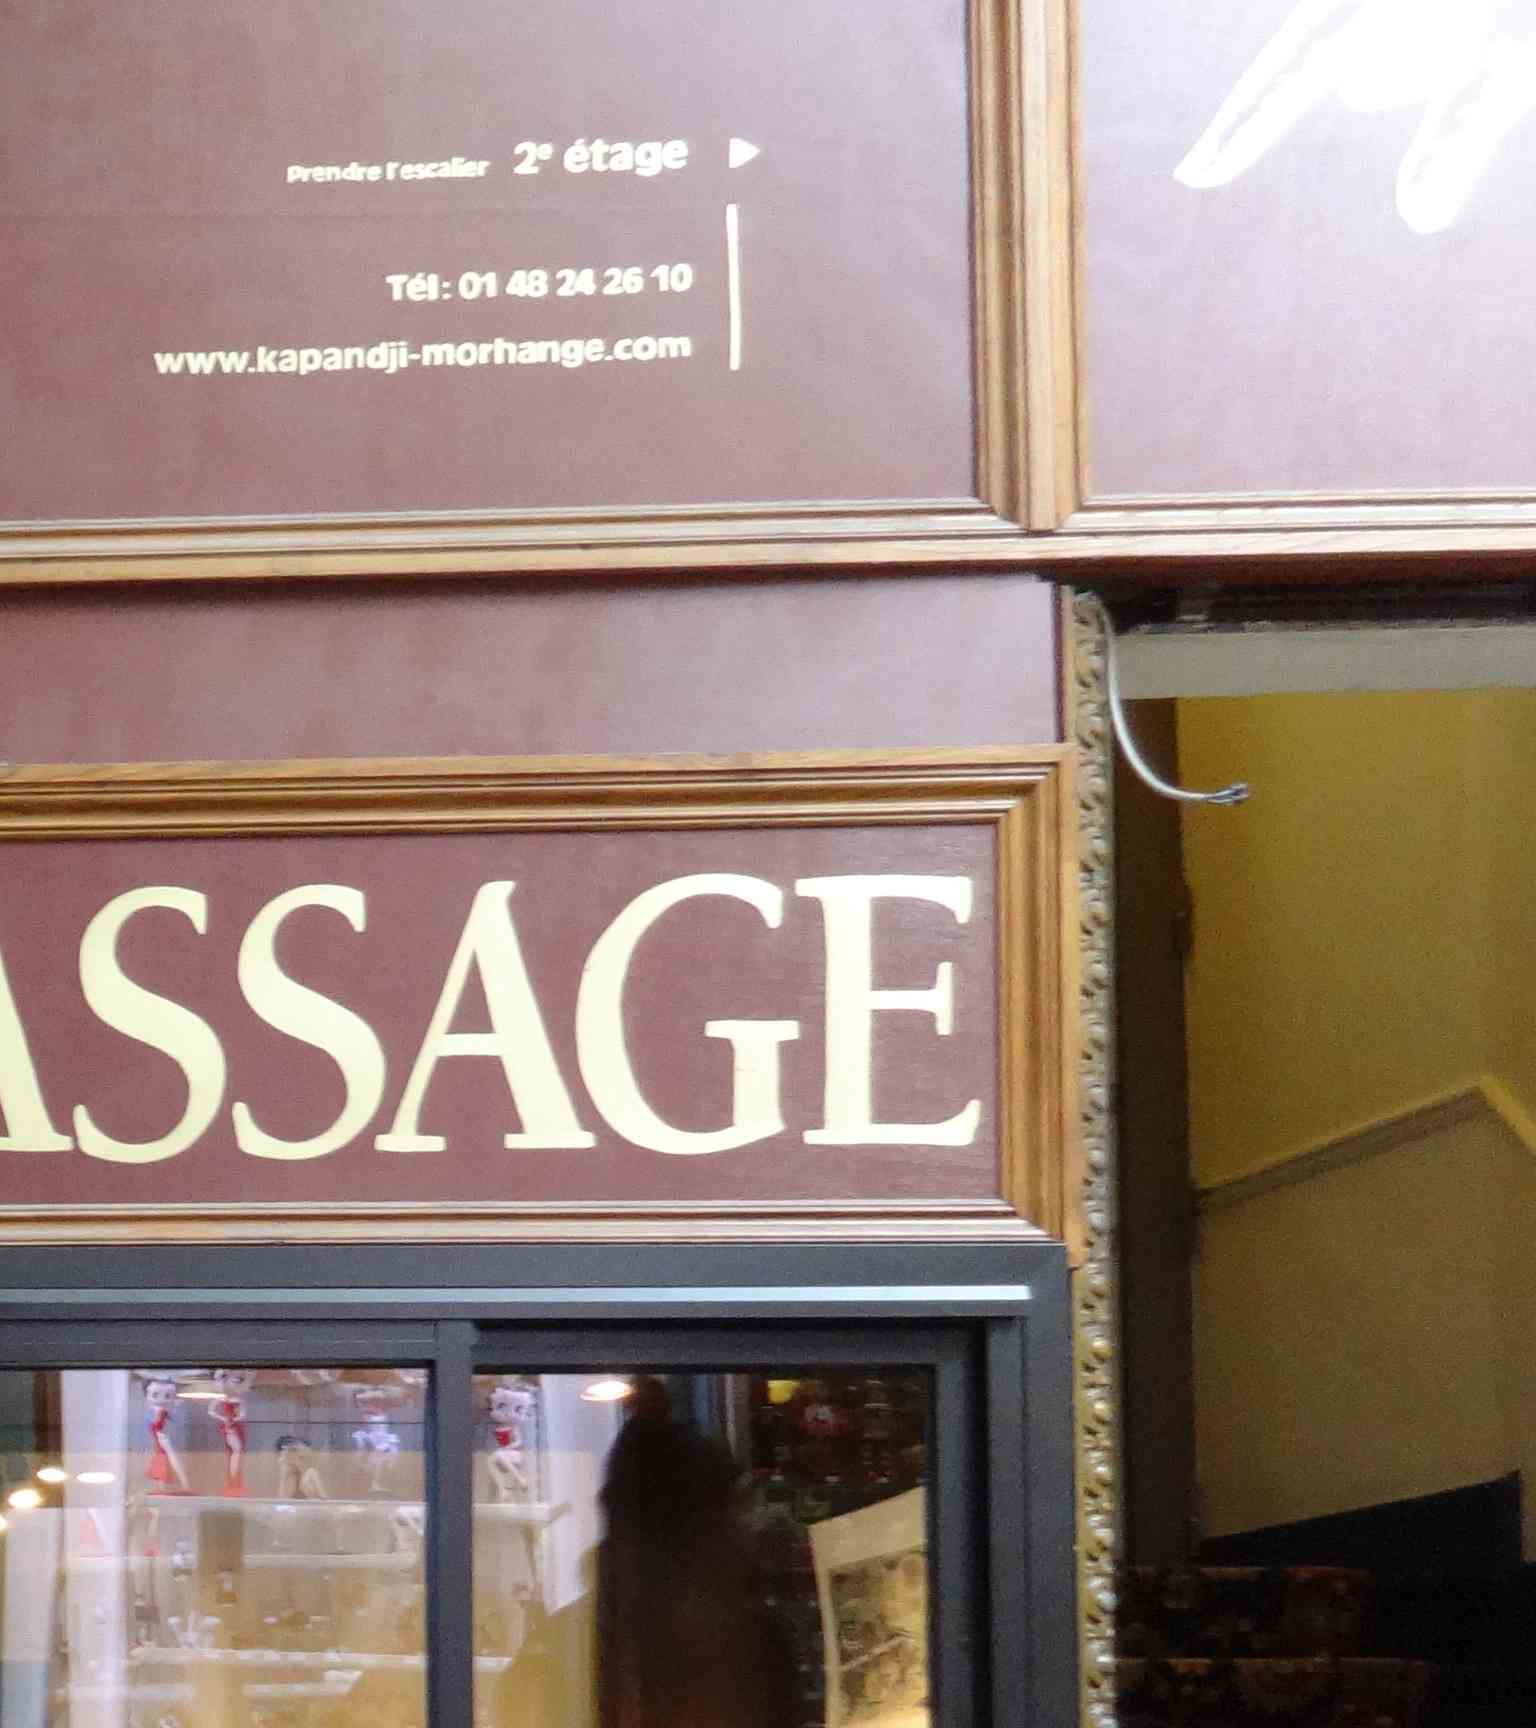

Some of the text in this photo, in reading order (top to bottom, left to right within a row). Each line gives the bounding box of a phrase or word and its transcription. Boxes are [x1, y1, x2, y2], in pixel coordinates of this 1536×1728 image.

[562, 138, 690, 177] étage
[458, 269, 498, 300] 01
[505, 267, 549, 299] 48
[555, 266, 598, 297] 24
[602, 264, 646, 296] 26
[648, 262, 694, 294] 10
[153, 334, 694, 376] www.kapandji-morhange.com
